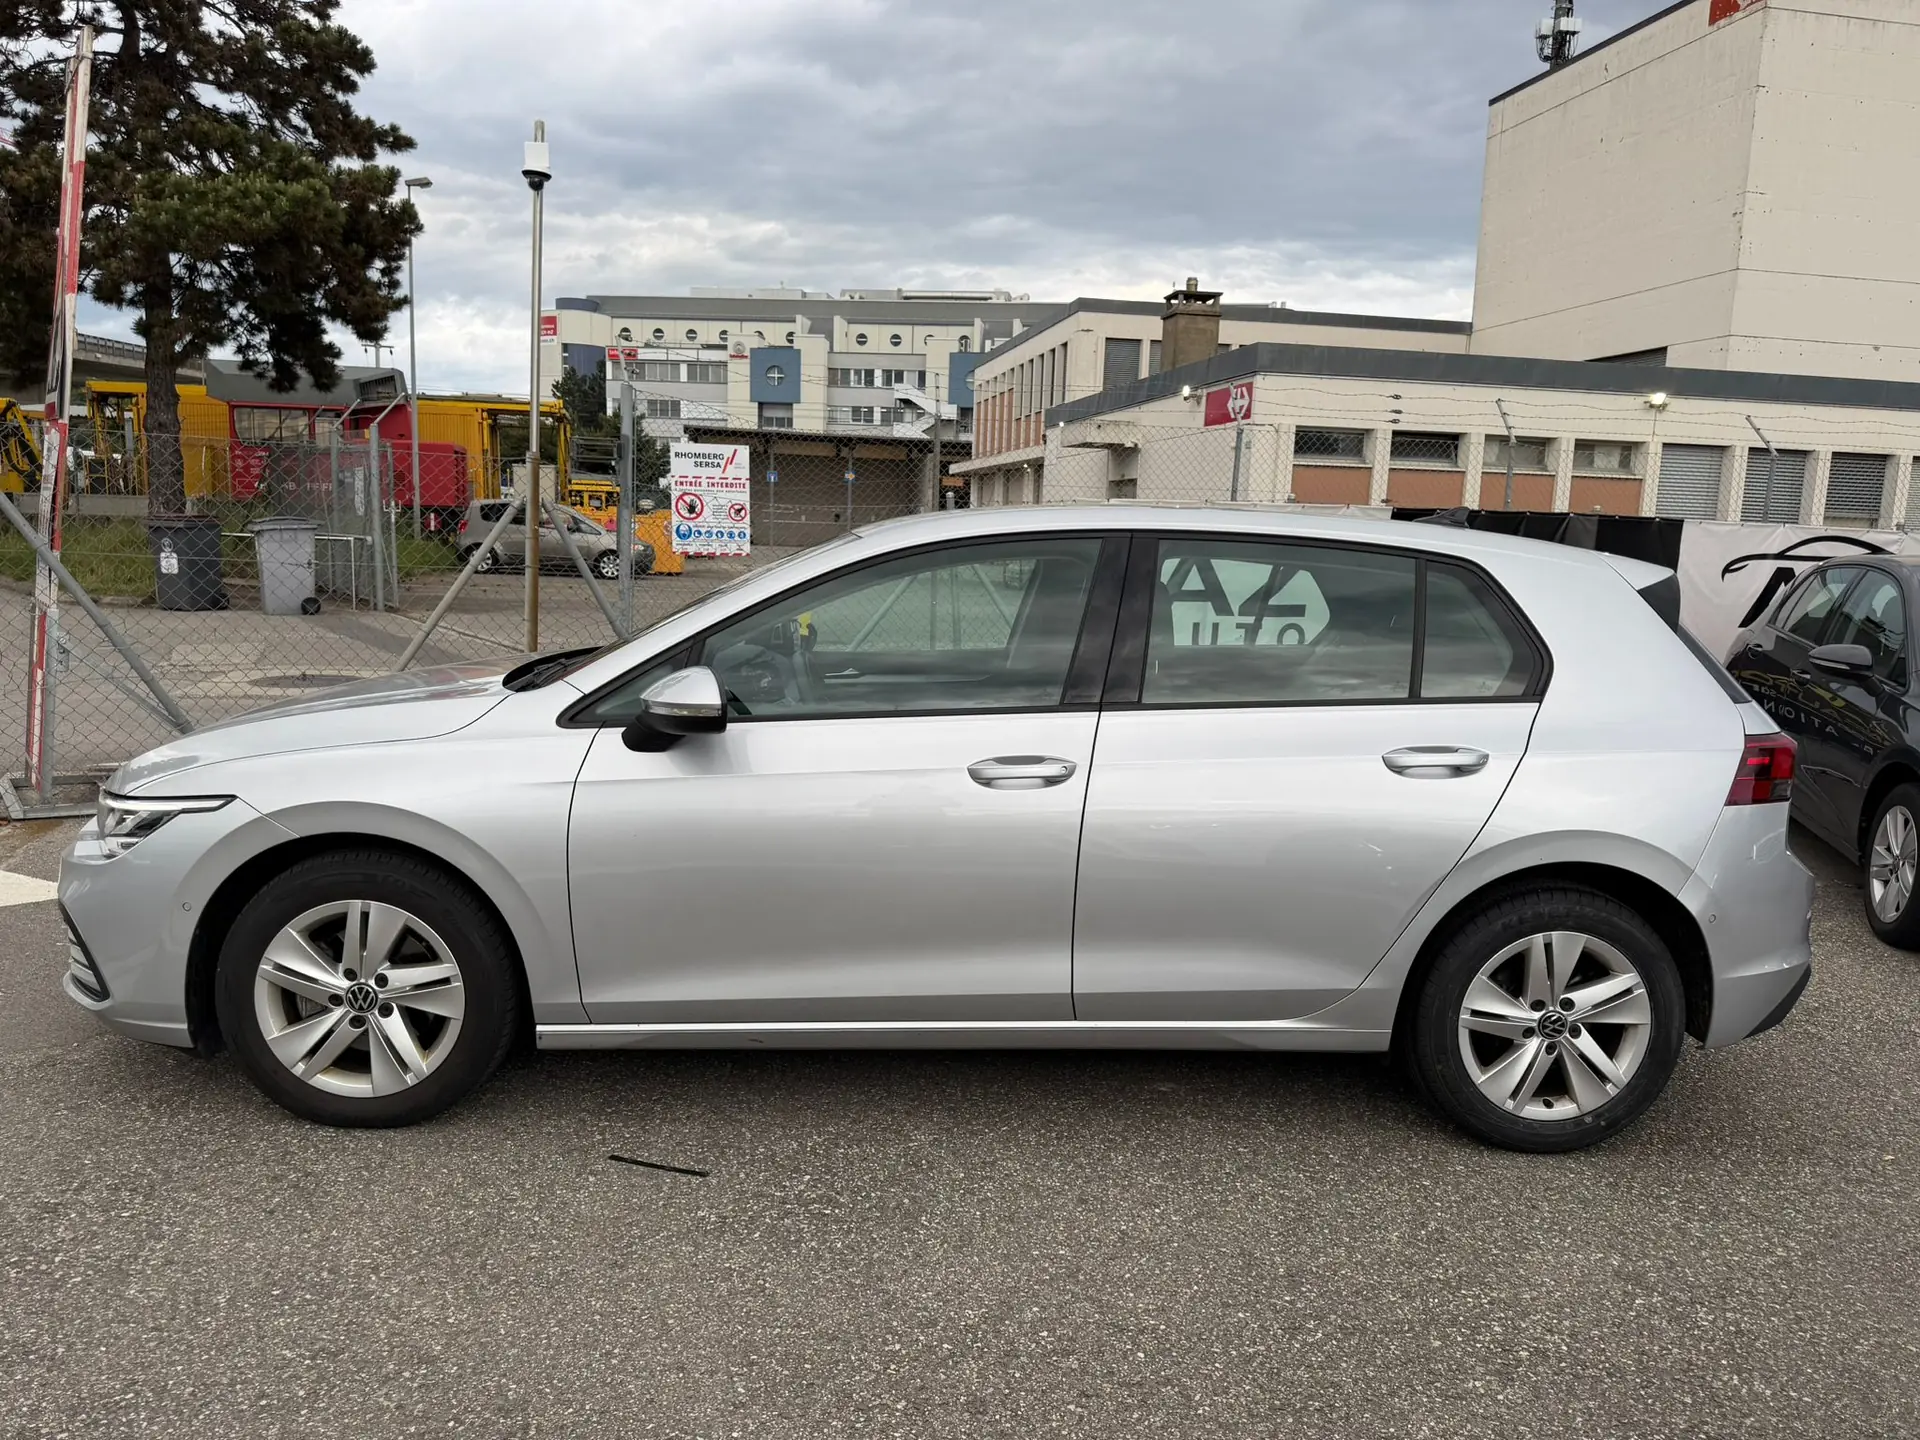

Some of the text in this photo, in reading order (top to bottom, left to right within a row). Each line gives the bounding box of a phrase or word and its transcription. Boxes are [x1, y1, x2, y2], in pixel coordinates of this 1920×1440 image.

[674, 451, 725, 460] RHOMBERG
[693, 460, 722, 469] SERSA
[674, 480, 746, 489] ENTRÉE INTERDITE
